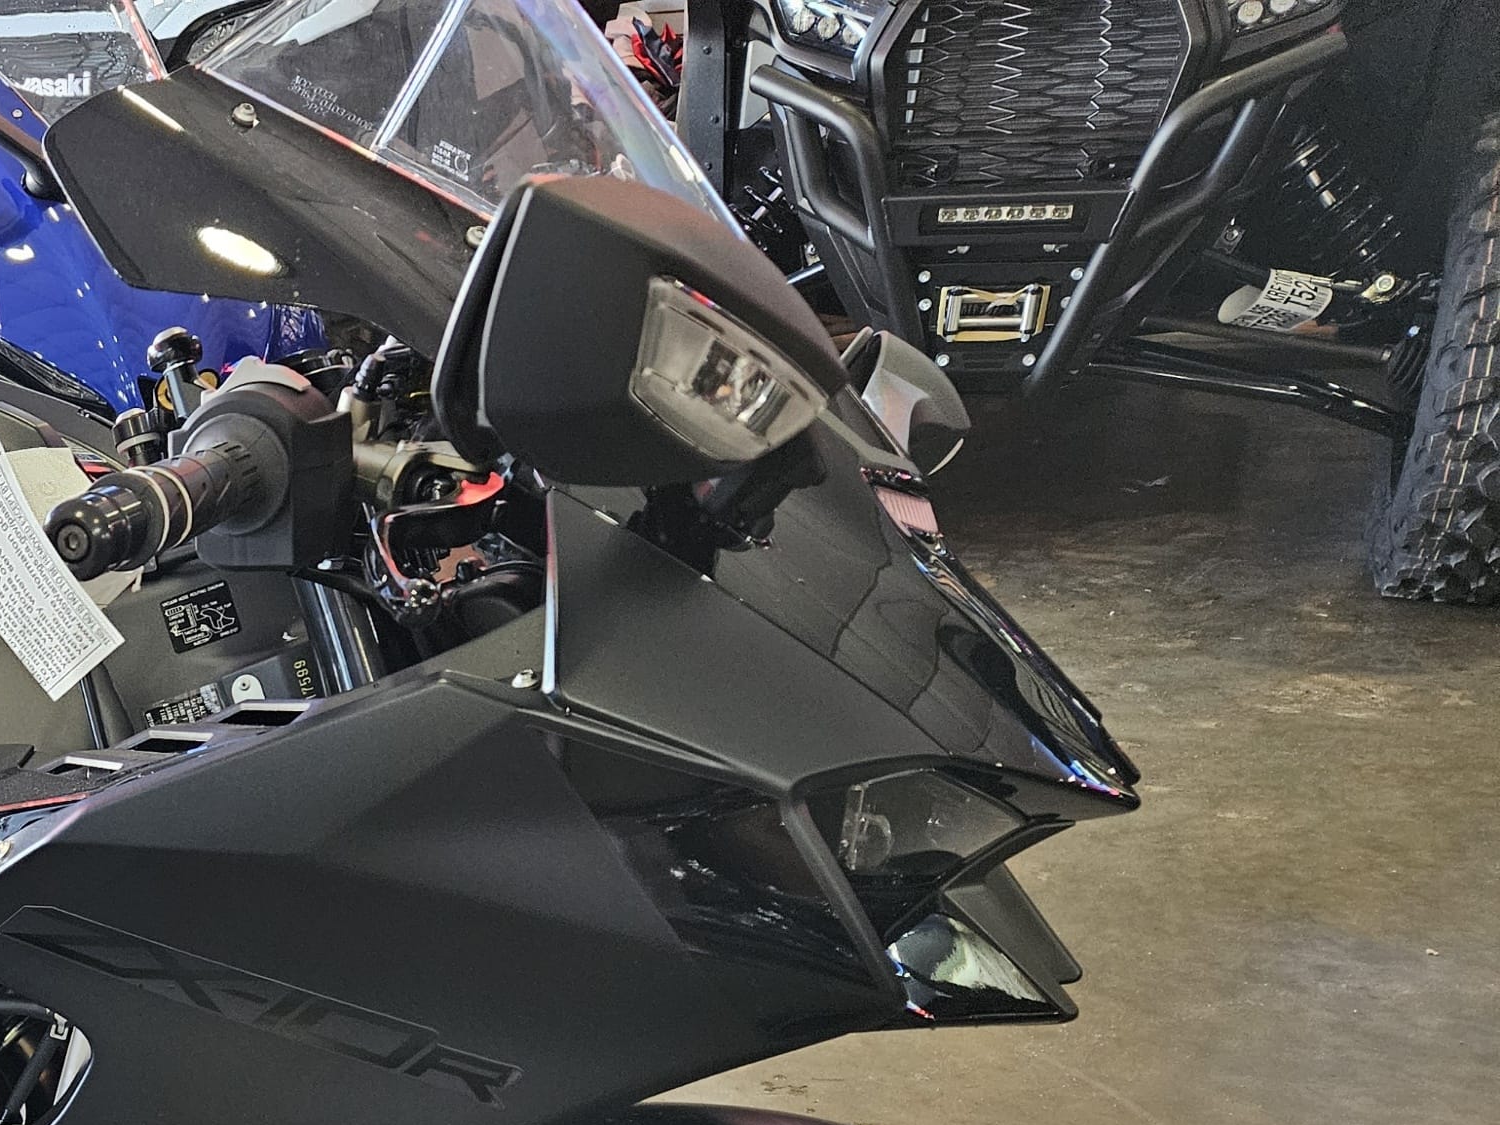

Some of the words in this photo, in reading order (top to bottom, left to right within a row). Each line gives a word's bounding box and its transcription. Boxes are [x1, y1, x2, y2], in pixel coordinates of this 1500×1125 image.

[3, 492, 27, 527] EXCEPT
[21, 524, 51, 566] REMOVED
[4, 532, 51, 599] information
[4, 575, 35, 615] gloves
[11, 572, 37, 606] when
[3, 600, 33, 637] except
[15, 605, 48, 644] vehicle
[31, 615, 55, 643] wear
[33, 604, 77, 661] frequently
[47, 599, 72, 630] more
[47, 611, 83, 656] vehicle.
[0, 620, 40, 667] minimize
[16, 628, 58, 679] breathing
[32, 636, 63, 674] engine
[47, 644, 68, 669] your
[52, 643, 71, 665] and
[70, 629, 89, 650] For
